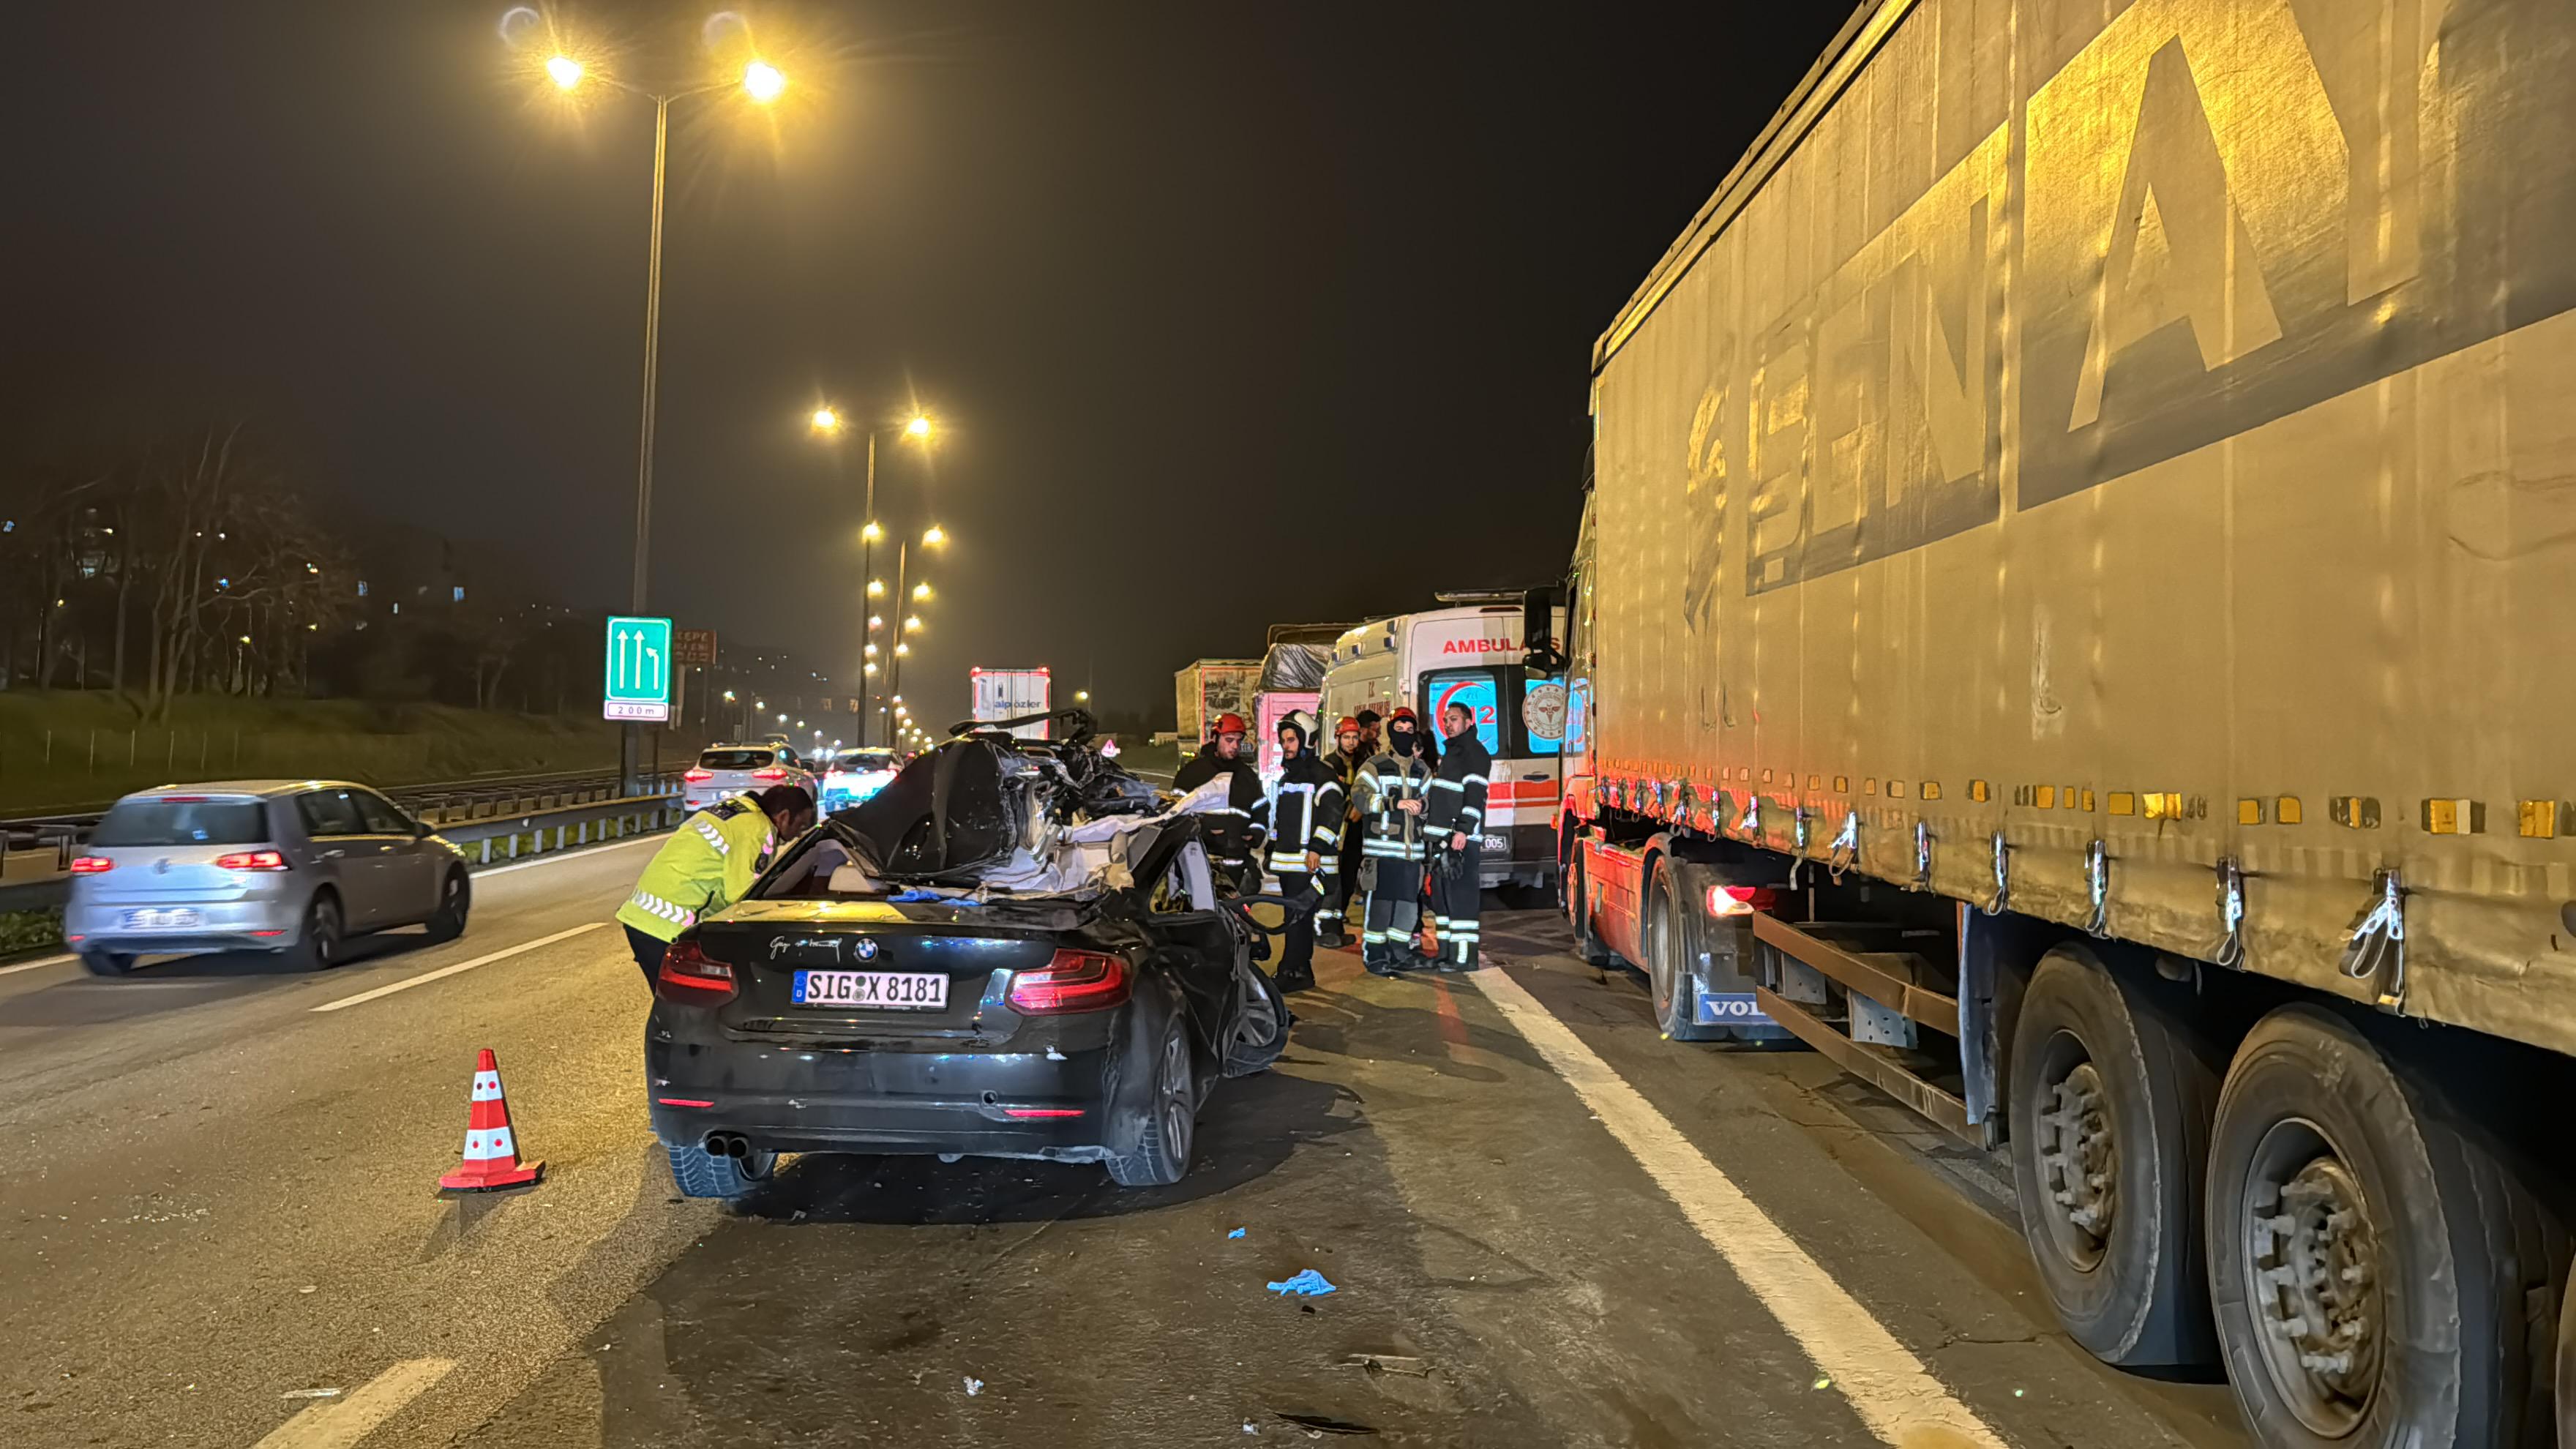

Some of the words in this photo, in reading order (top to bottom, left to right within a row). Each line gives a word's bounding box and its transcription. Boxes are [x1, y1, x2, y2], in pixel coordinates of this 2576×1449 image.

[1443, 638, 1560, 654] AMBULS
[1469, 705, 1496, 724] 12
[1486, 838, 1503, 849] 005
[796, 990, 802, 998] D
[886, 977, 942, 1003] 8181
[1706, 1000, 1767, 1016] VOL
